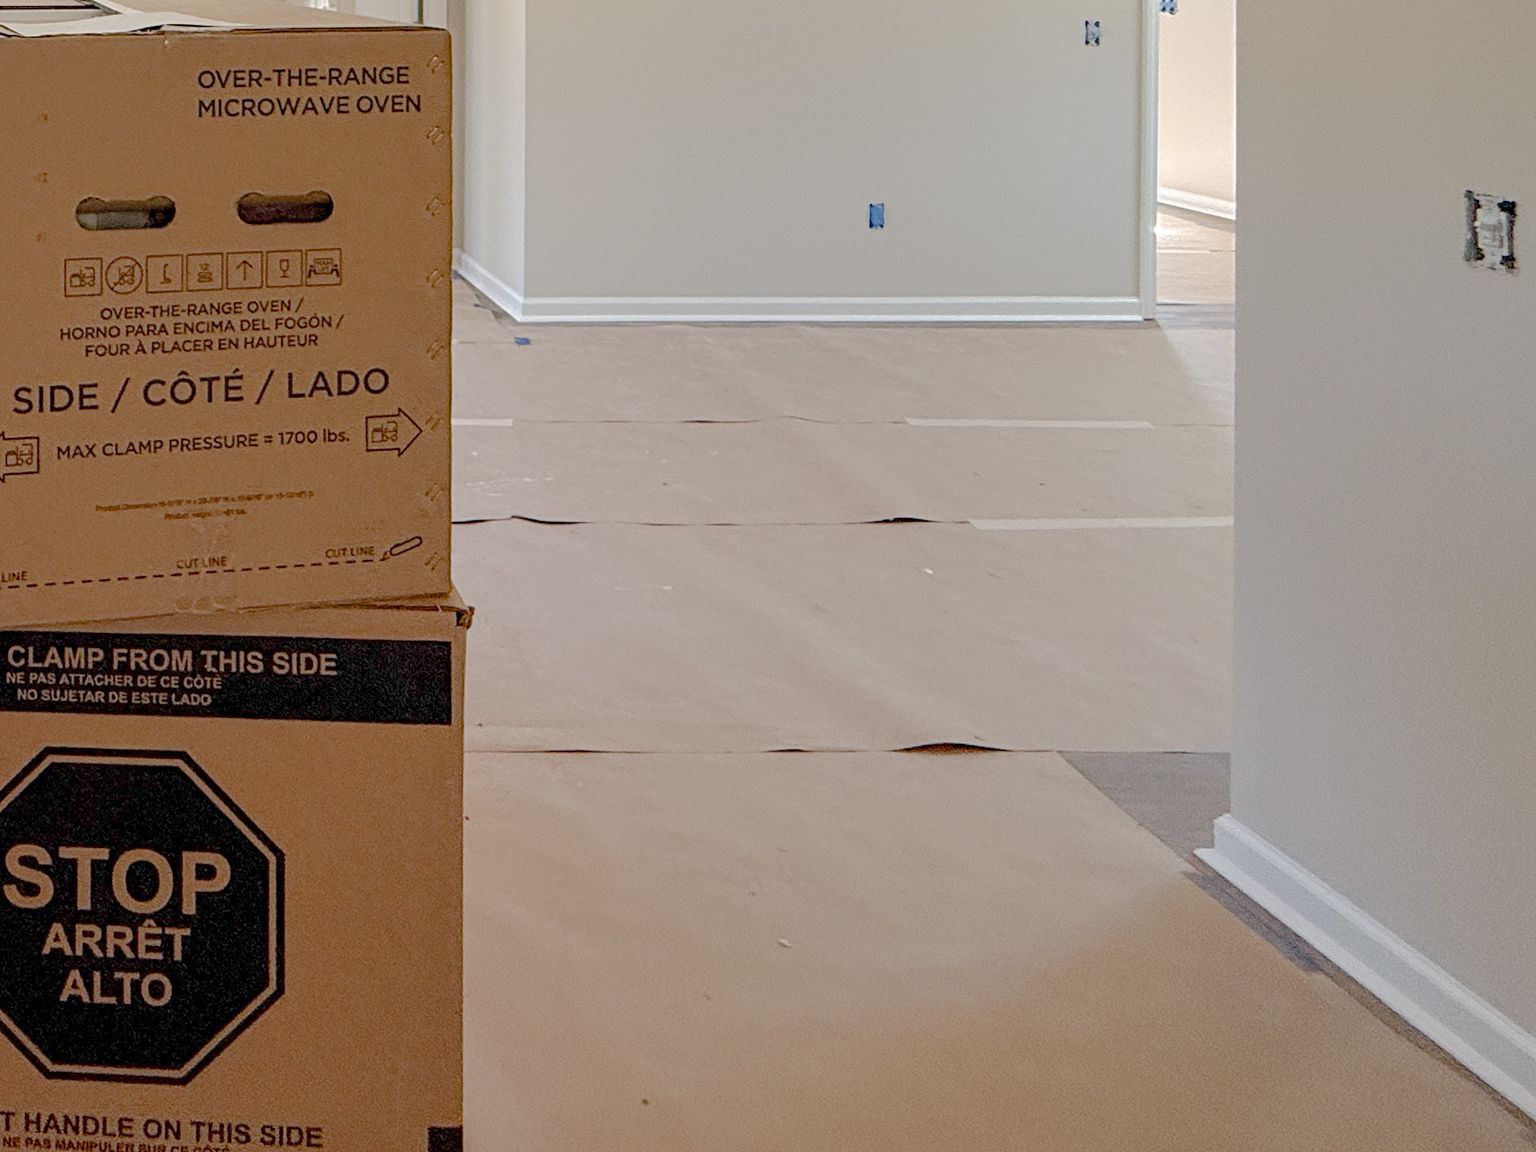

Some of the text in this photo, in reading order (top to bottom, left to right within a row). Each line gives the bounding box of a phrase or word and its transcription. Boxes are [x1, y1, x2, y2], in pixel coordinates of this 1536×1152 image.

[197, 66, 410, 89] OVER-THE-RANGE
[197, 94, 422, 118] MICROWAVE OVEN
[100, 297, 304, 321] OVER-THE-RANGE OVEN /
[60, 313, 345, 341] HORNO PARA ENCIMA DEL FOGÓN /
[85, 334, 319, 358] FOUR À PLACER EN HAUTEUR
[12, 367, 391, 415] SIDE / CÔTÉ / LADO
[56, 445, 98, 461] MAX
[102, 439, 164, 458] CLAMP
[168, 433, 260, 453] PRESSURE
[277, 428, 319, 446] 1700
[322, 426, 350, 445] lbs.
[176, 556, 227, 570] CUT LINE
[325, 545, 376, 559] CUT LINE
[0, 570, 28, 583] LINE
[7, 645, 105, 670] CLAMP
[112, 647, 193, 672] FROM
[200, 649, 264, 673] THIS
[272, 651, 338, 677] SIDE
[6, 671, 25, 685] NE
[29, 672, 57, 686] PAS
[60, 672, 134, 688] ATTACHER
[138, 675, 157, 689] DE
[160, 675, 181, 689] CE
[16, 688, 212, 707] NO SUJETAR DE ESTE LADO
[1, 843, 232, 917] STOP
[41, 919, 192, 961] ARRÊT
[59, 969, 174, 1008] ALTO
[23, 1112, 135, 1139] HANDLE
[142, 1117, 182, 1141] ON
[190, 1119, 251, 1145] THIS
[259, 1124, 324, 1148] SIDE
[2, 1136, 21, 1148] NE
[25, 1137, 52, 1150] PAS
